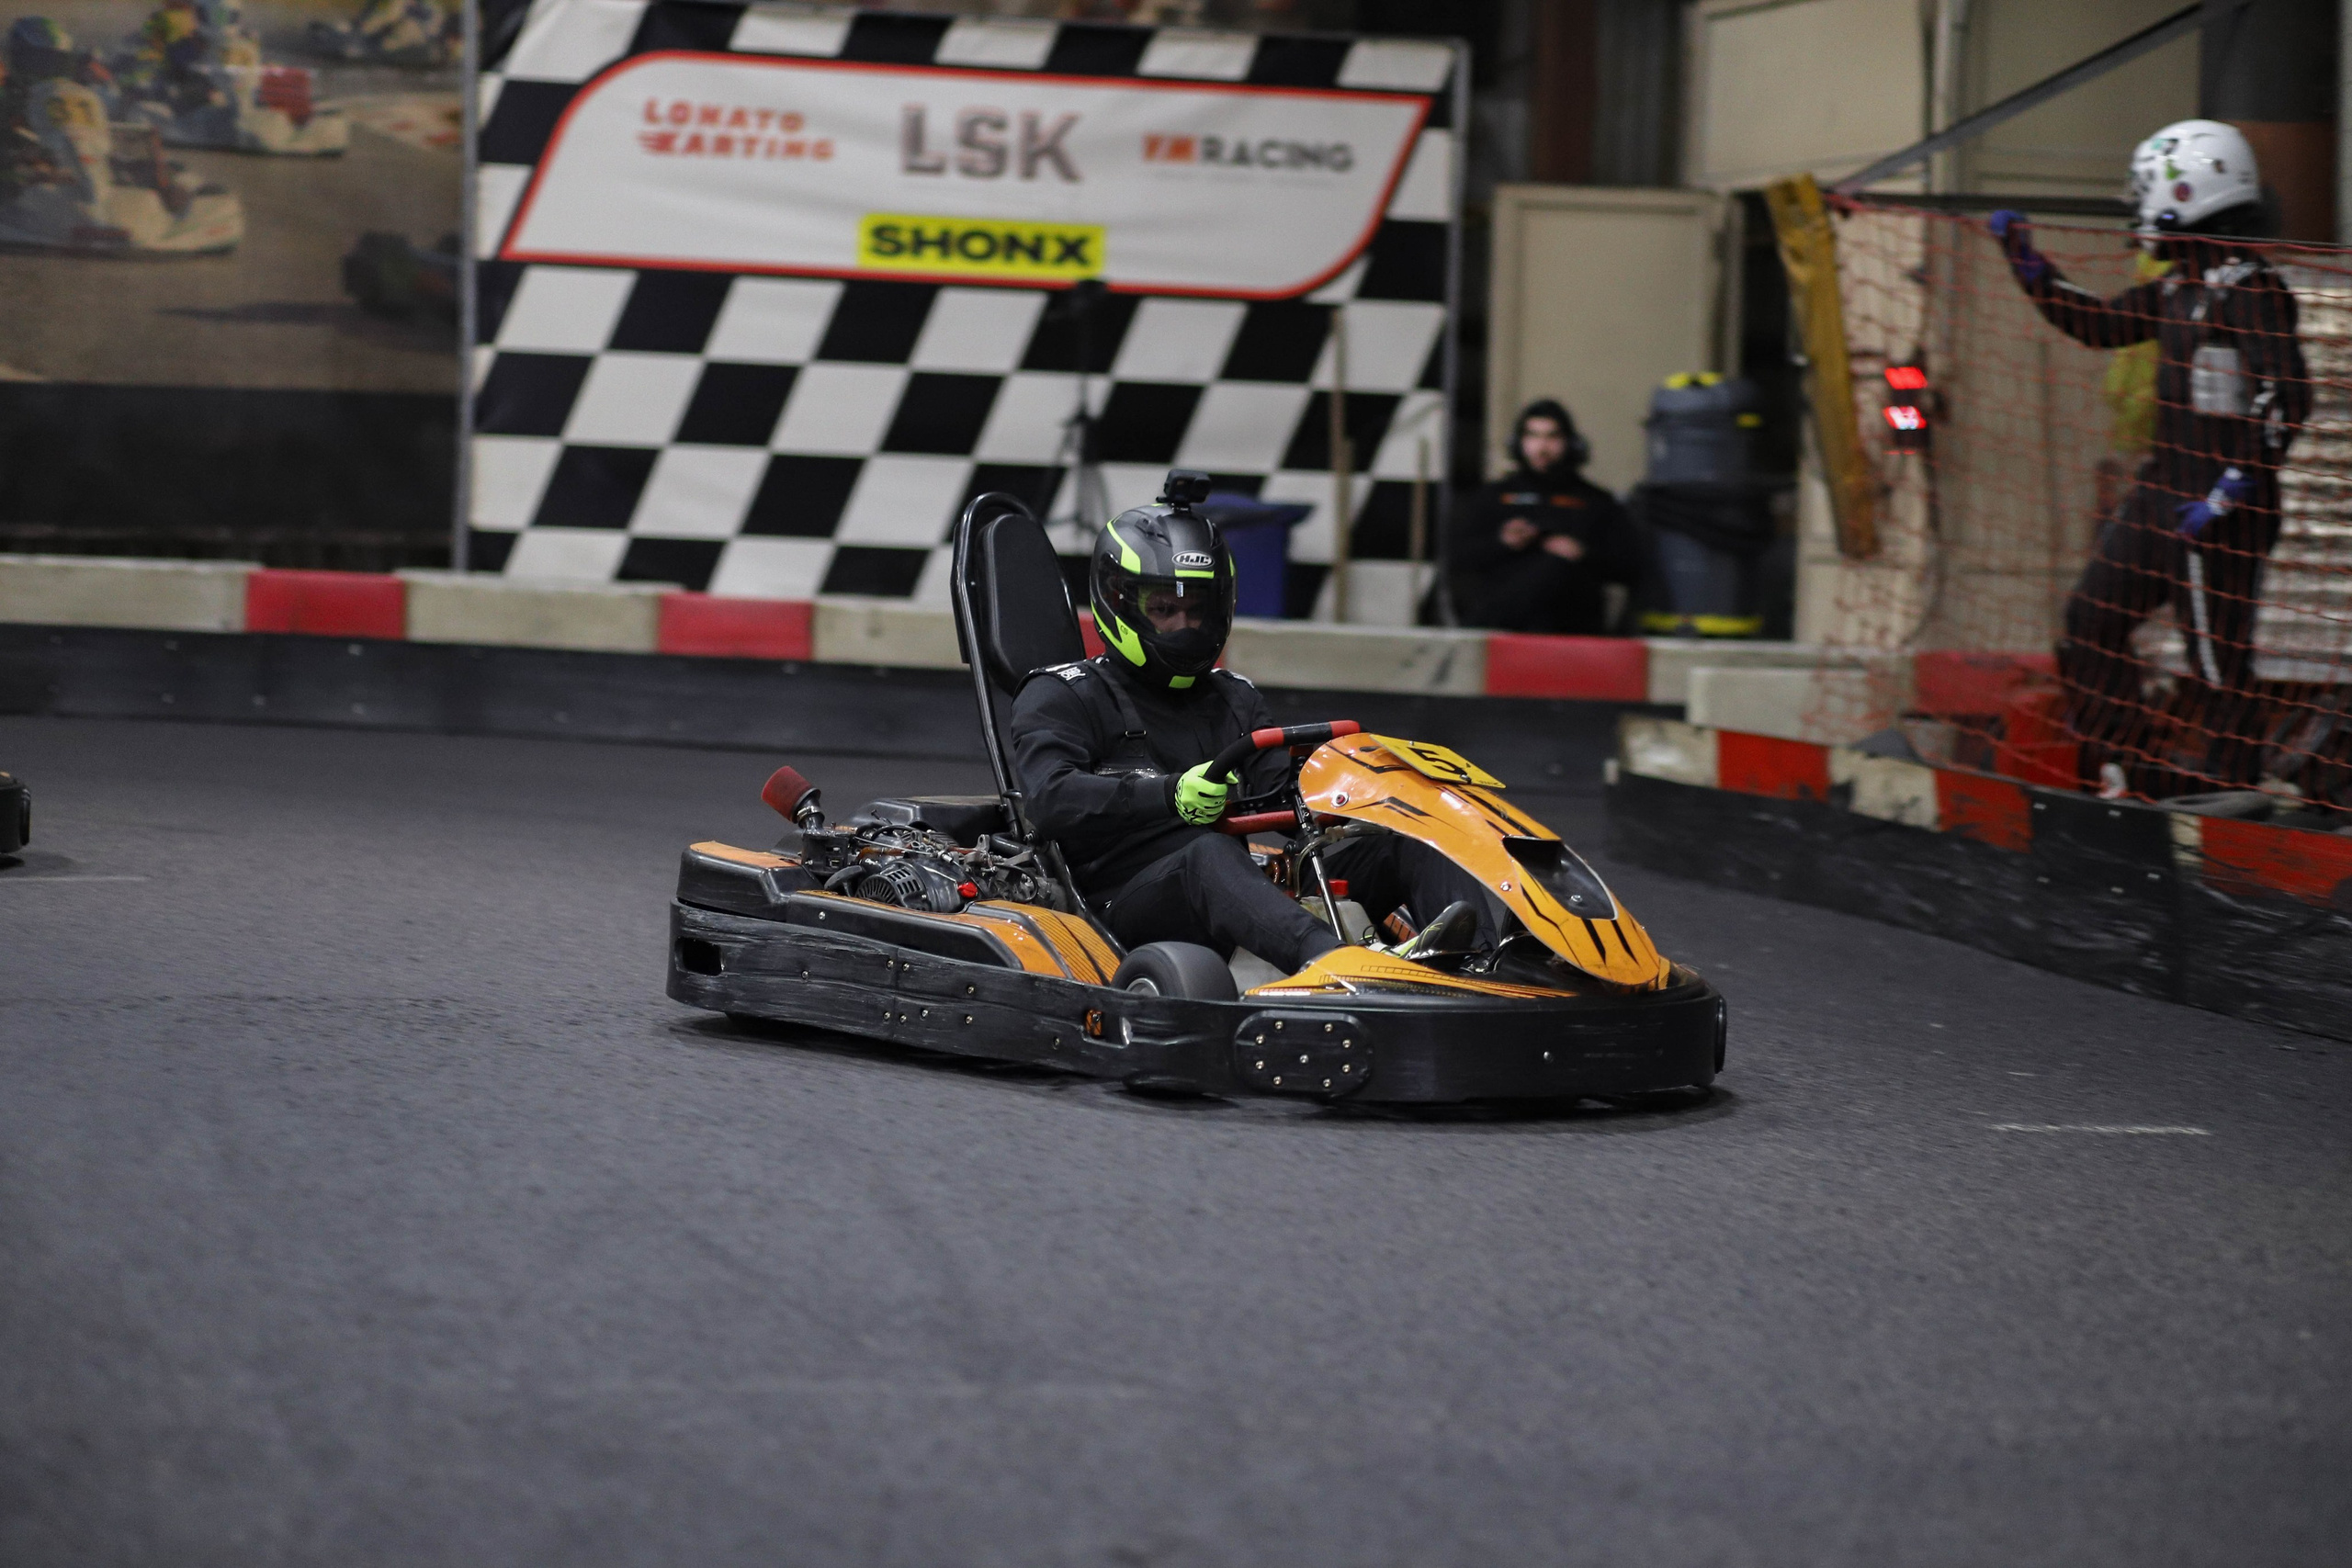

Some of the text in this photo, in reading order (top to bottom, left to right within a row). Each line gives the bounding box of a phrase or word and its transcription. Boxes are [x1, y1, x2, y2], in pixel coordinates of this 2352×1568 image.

[638, 131, 835, 162] KARTING
[900, 102, 1082, 184] LSK
[1201, 134, 1354, 174] RACING
[868, 222, 1091, 268] SHONX
[1179, 555, 1209, 564] HJC
